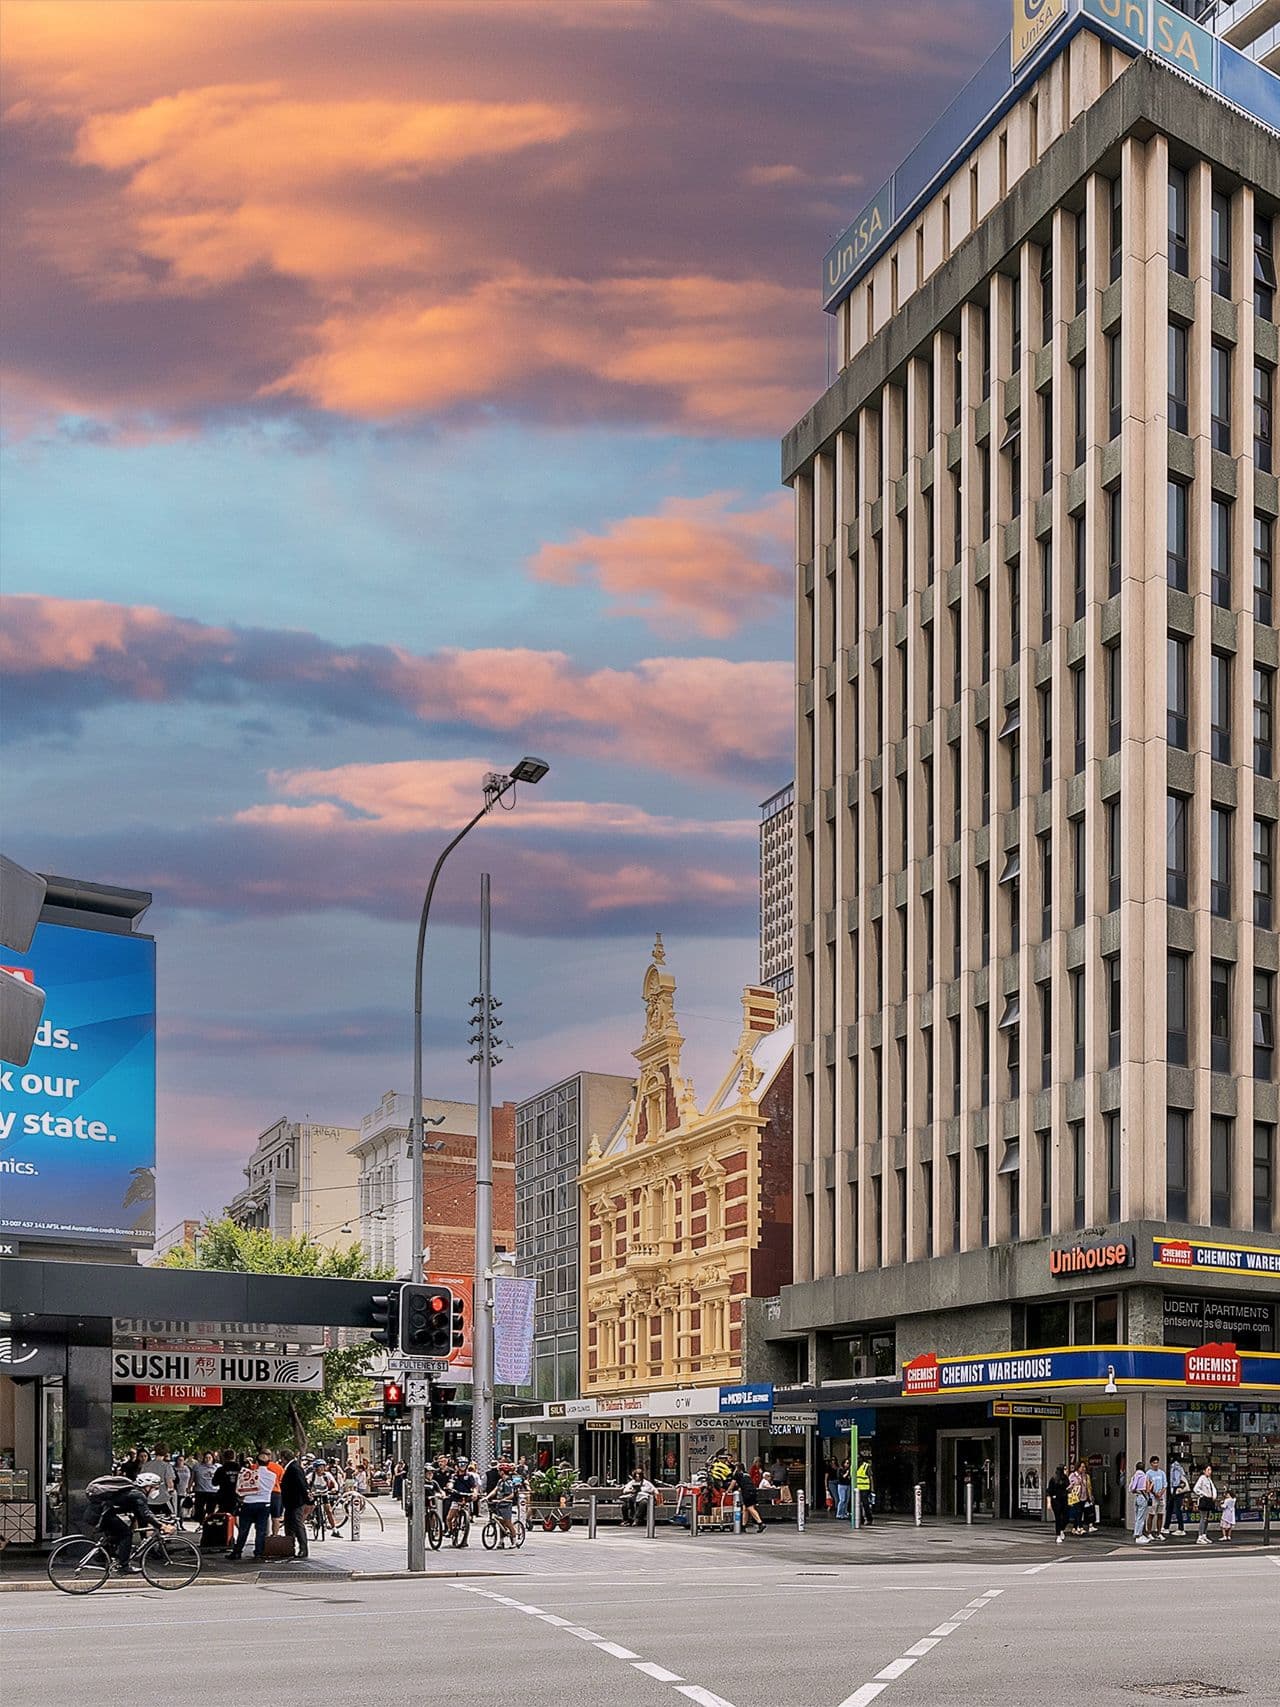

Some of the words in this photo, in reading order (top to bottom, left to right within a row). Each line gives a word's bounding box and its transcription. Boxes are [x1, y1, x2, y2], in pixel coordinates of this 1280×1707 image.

[829, 207, 882, 286] UniSA
[21, 1074, 79, 1098] our
[23, 1111, 117, 1142] state.
[1049, 1242, 1127, 1274] Unihouse
[1162, 1247, 1191, 1259] CHEMIST
[1162, 1256, 1191, 1264] WAREHOUSE
[1197, 1249, 1242, 1267] CHEMIST
[1164, 1301, 1199, 1313] UDENT
[1205, 1303, 1269, 1319] APARTMENTS
[114, 1353, 190, 1380] SUSHI
[220, 1358, 270, 1382] HUB
[437, 1362, 445, 1370] ST
[942, 1363, 984, 1385] CHEMIST
[988, 1358, 1052, 1381] WAREHOUSE
[1188, 1356, 1238, 1373] CHEMIST
[907, 1366, 938, 1382] CHEMIST
[1189, 1372, 1237, 1382] WAREHOUSE
[149, 1385, 165, 1397] EYE
[169, 1385, 207, 1398] TESTING
[907, 1381, 937, 1390] WAREHOUSE
[1208, 1402, 1222, 1411] OFF
[629, 1419, 662, 1432] Bailey
[695, 1419, 728, 1427] OSCAR
[735, 1419, 768, 1427] WYLEE
[769, 1424, 792, 1435] OSCAR
